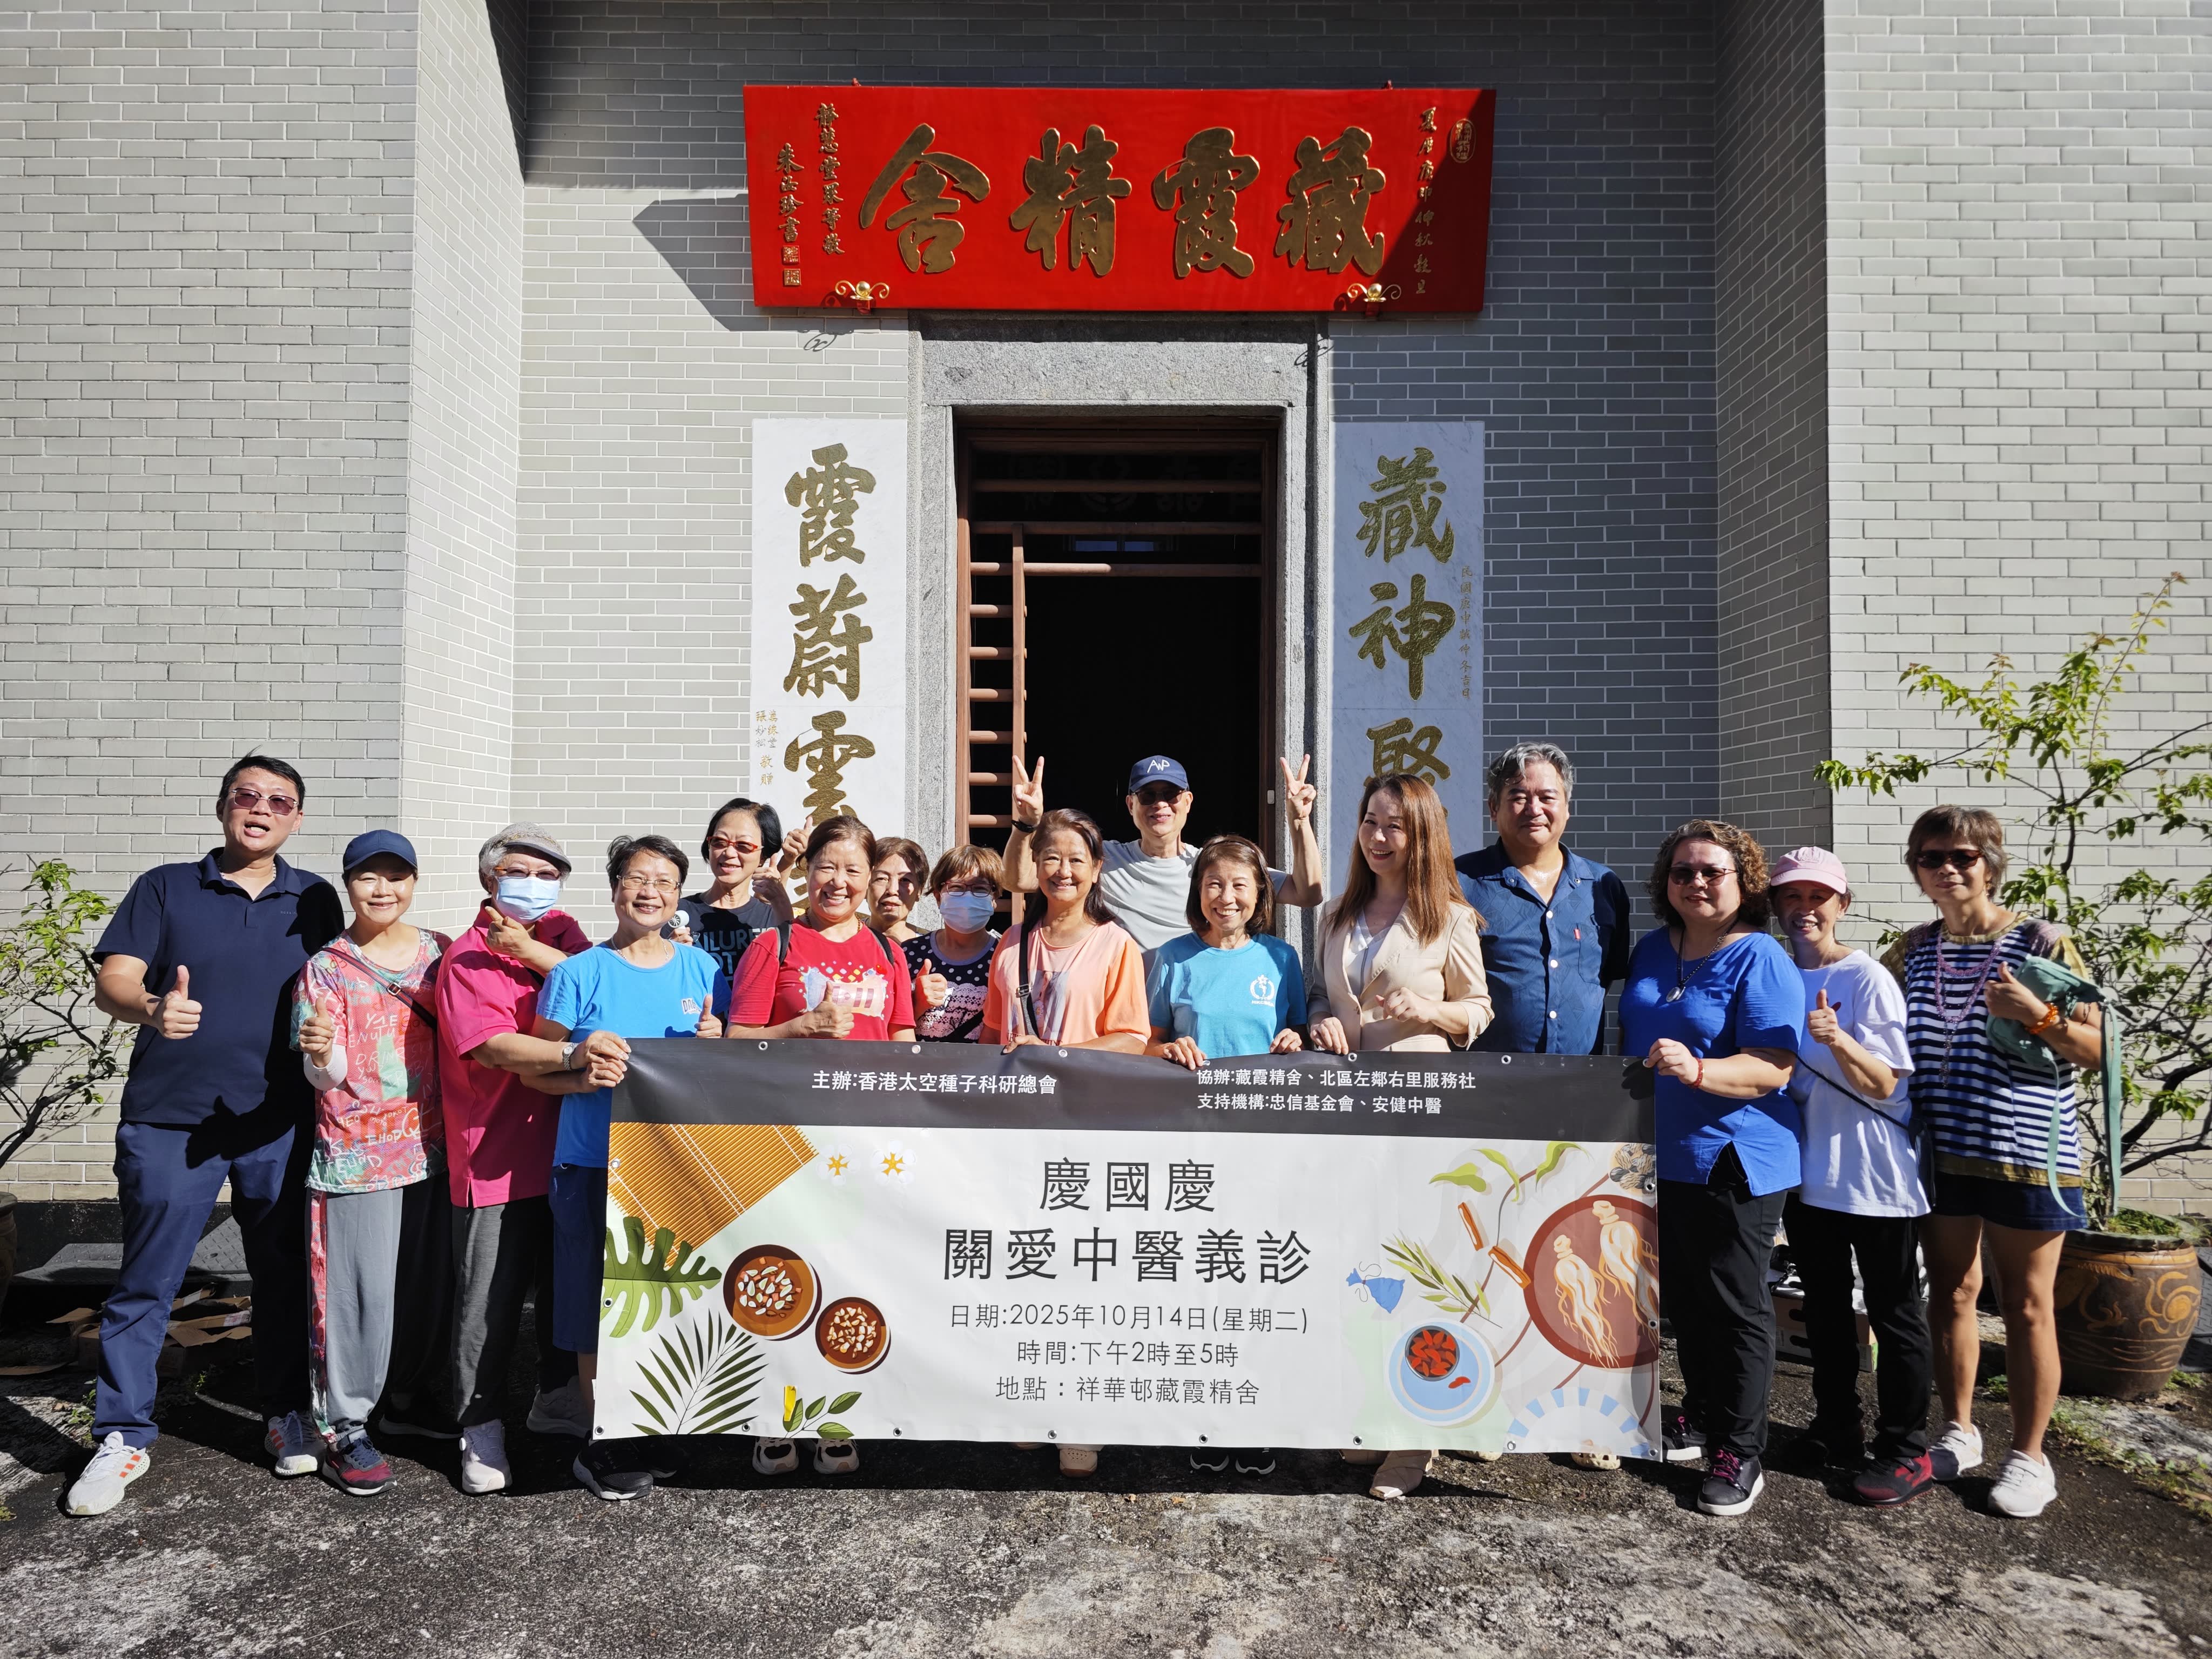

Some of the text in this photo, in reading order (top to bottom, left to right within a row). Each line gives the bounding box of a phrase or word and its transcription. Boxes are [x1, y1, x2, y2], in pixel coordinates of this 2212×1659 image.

[860, 123, 1386, 278] 藏霞精舍
[783, 443, 876, 913] 霞蔚雲
[812, 1069, 1057, 1095] 主辦:香港太空種子科研總會
[1197, 1093, 1442, 1114] 支持機構:忠信基金會、安健中醫
[1040, 1157, 1215, 1212] 慶國慶
[944, 1226, 1311, 1285] 關愛中醫義診
[951, 1303, 1308, 1334] 日期:2025年10月14日(星期二)
[1017, 1339, 1239, 1368] 時間:下午2時至5時
